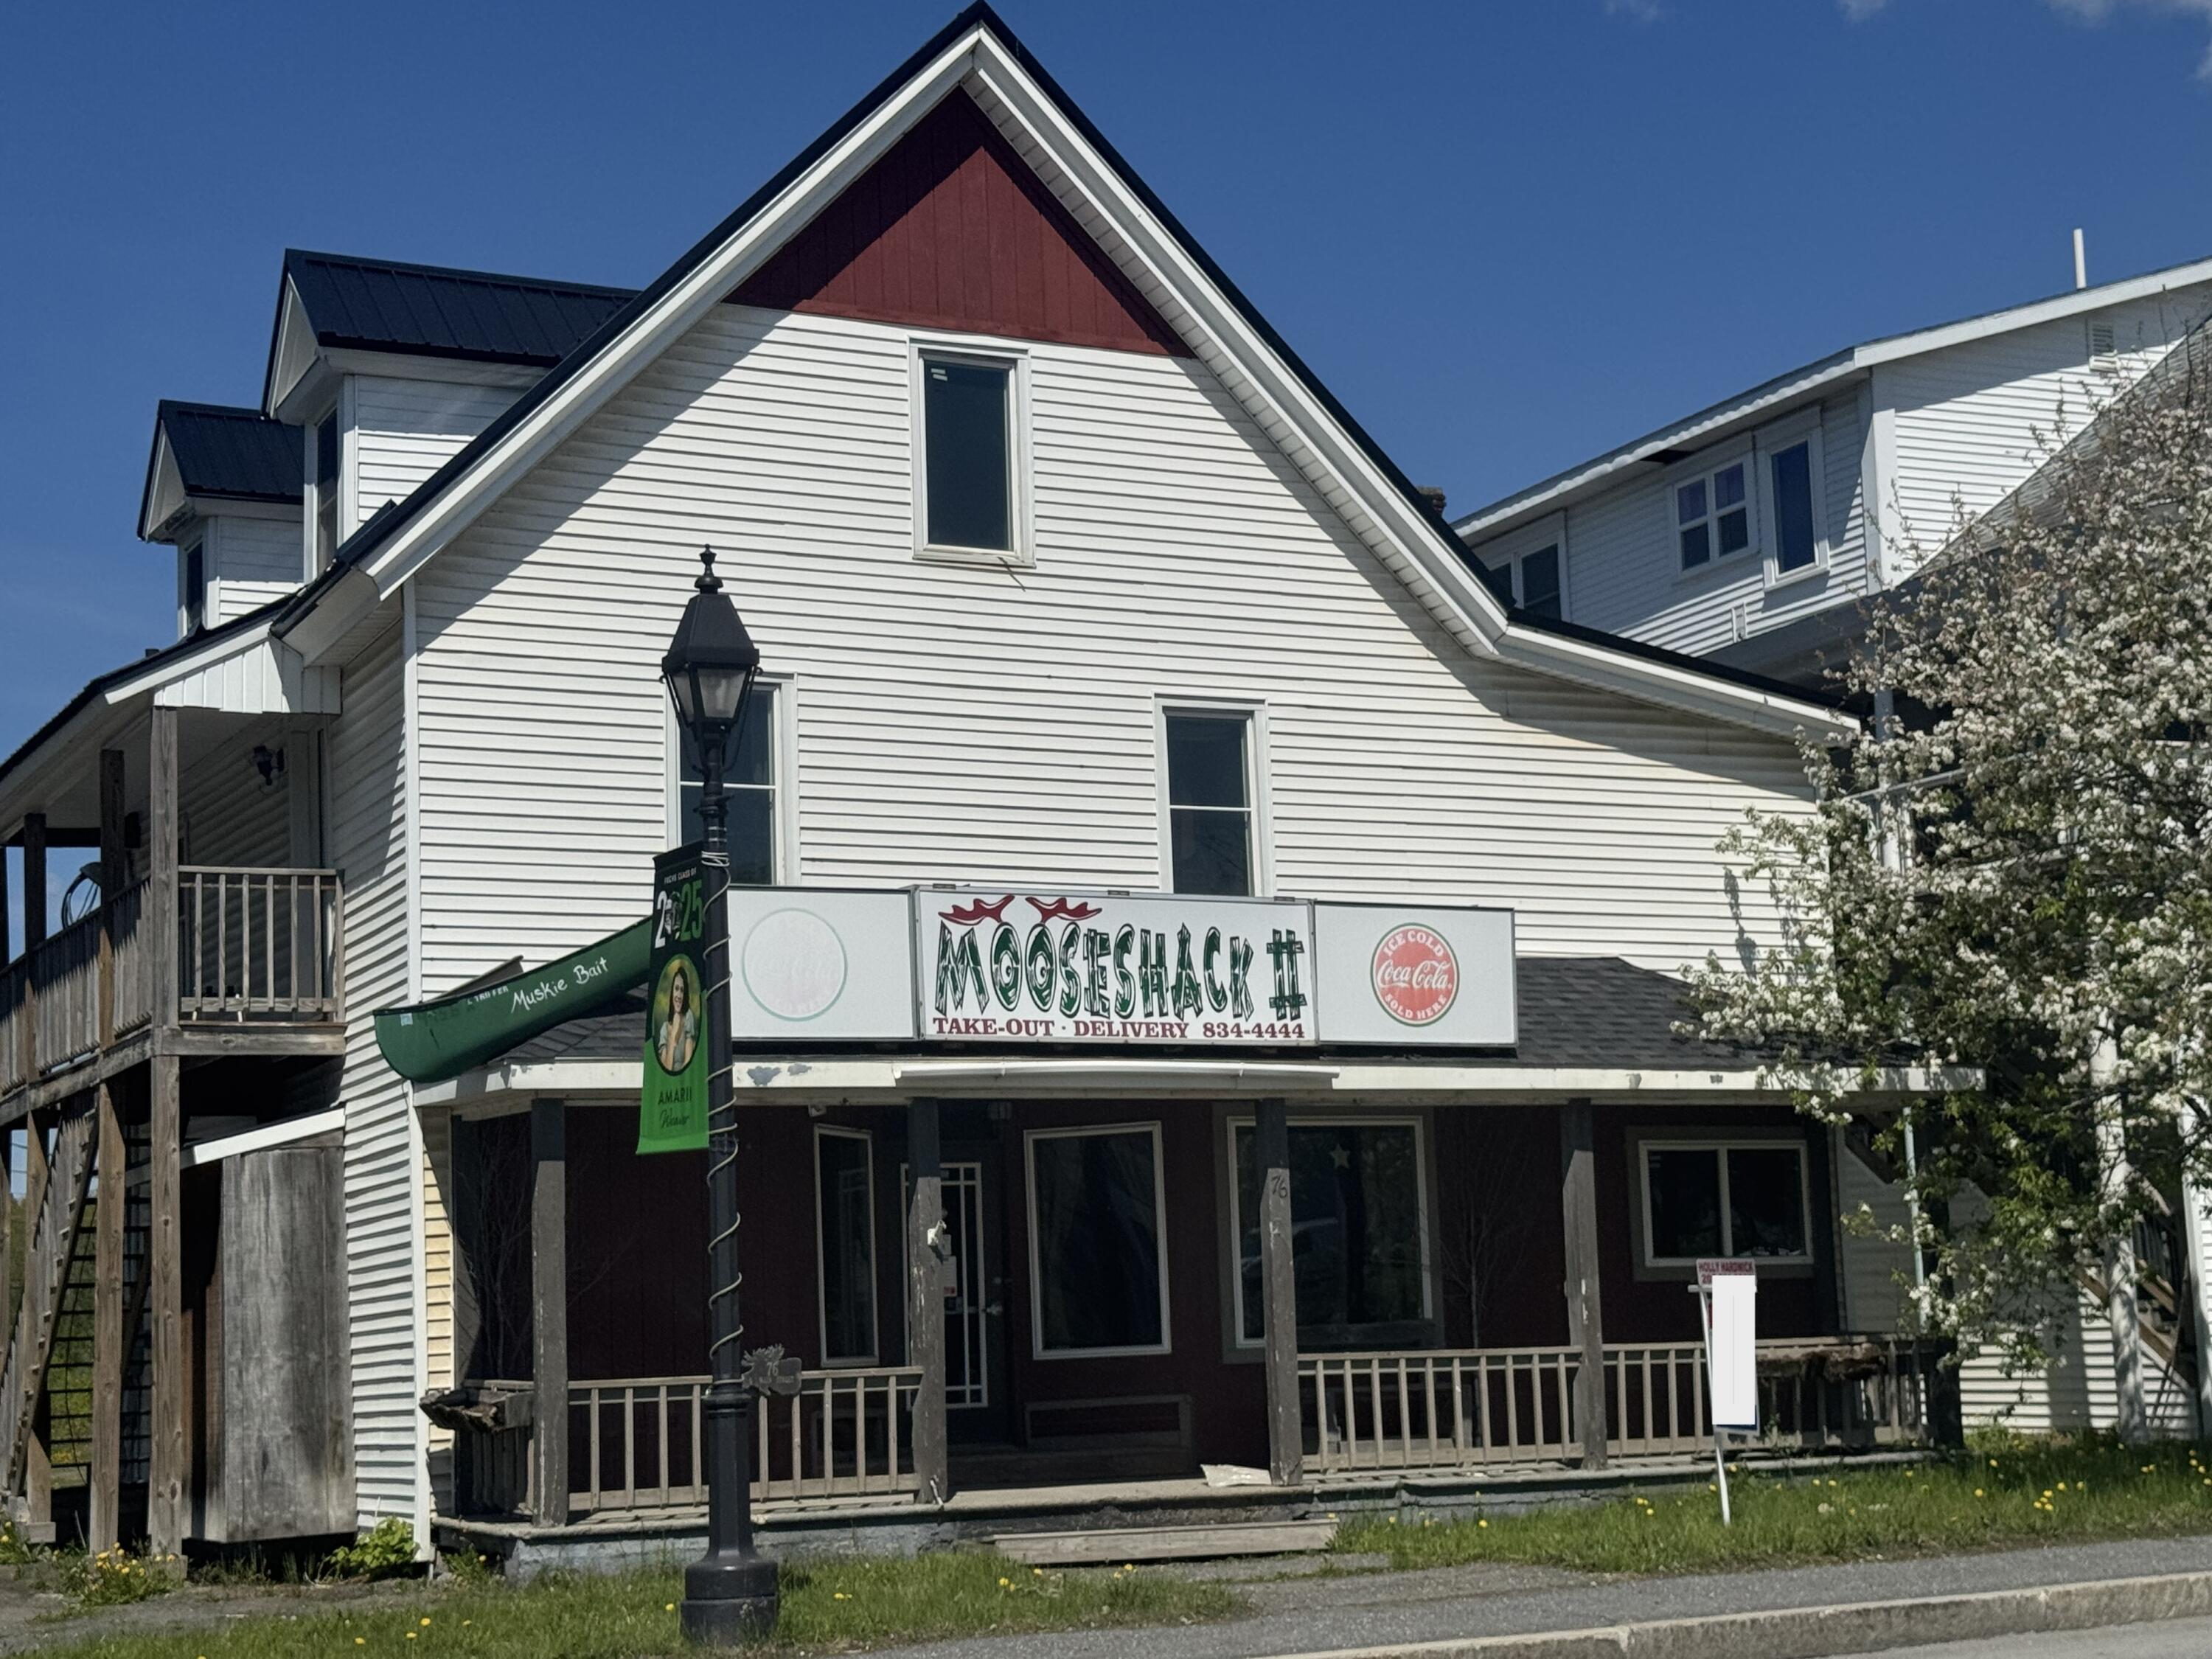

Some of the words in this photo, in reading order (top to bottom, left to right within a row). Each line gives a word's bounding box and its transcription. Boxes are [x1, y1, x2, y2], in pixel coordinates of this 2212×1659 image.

[1382, 933, 1406, 956] ICE
[1407, 930, 1444, 957] COLD
[510, 978, 568, 1015] Muskie
[573, 956, 610, 985] Bait
[1385, 994, 1413, 1018] SOLD
[1416, 995, 1447, 1019] HERE
[933, 1017, 1054, 1036] TAKE-OUT
[1074, 1020, 1190, 1039] DELIVERY
[1203, 1022, 1305, 1039] 834-4444
[1272, 1175, 1288, 1200] 76
[767, 1360, 779, 1377] 76
